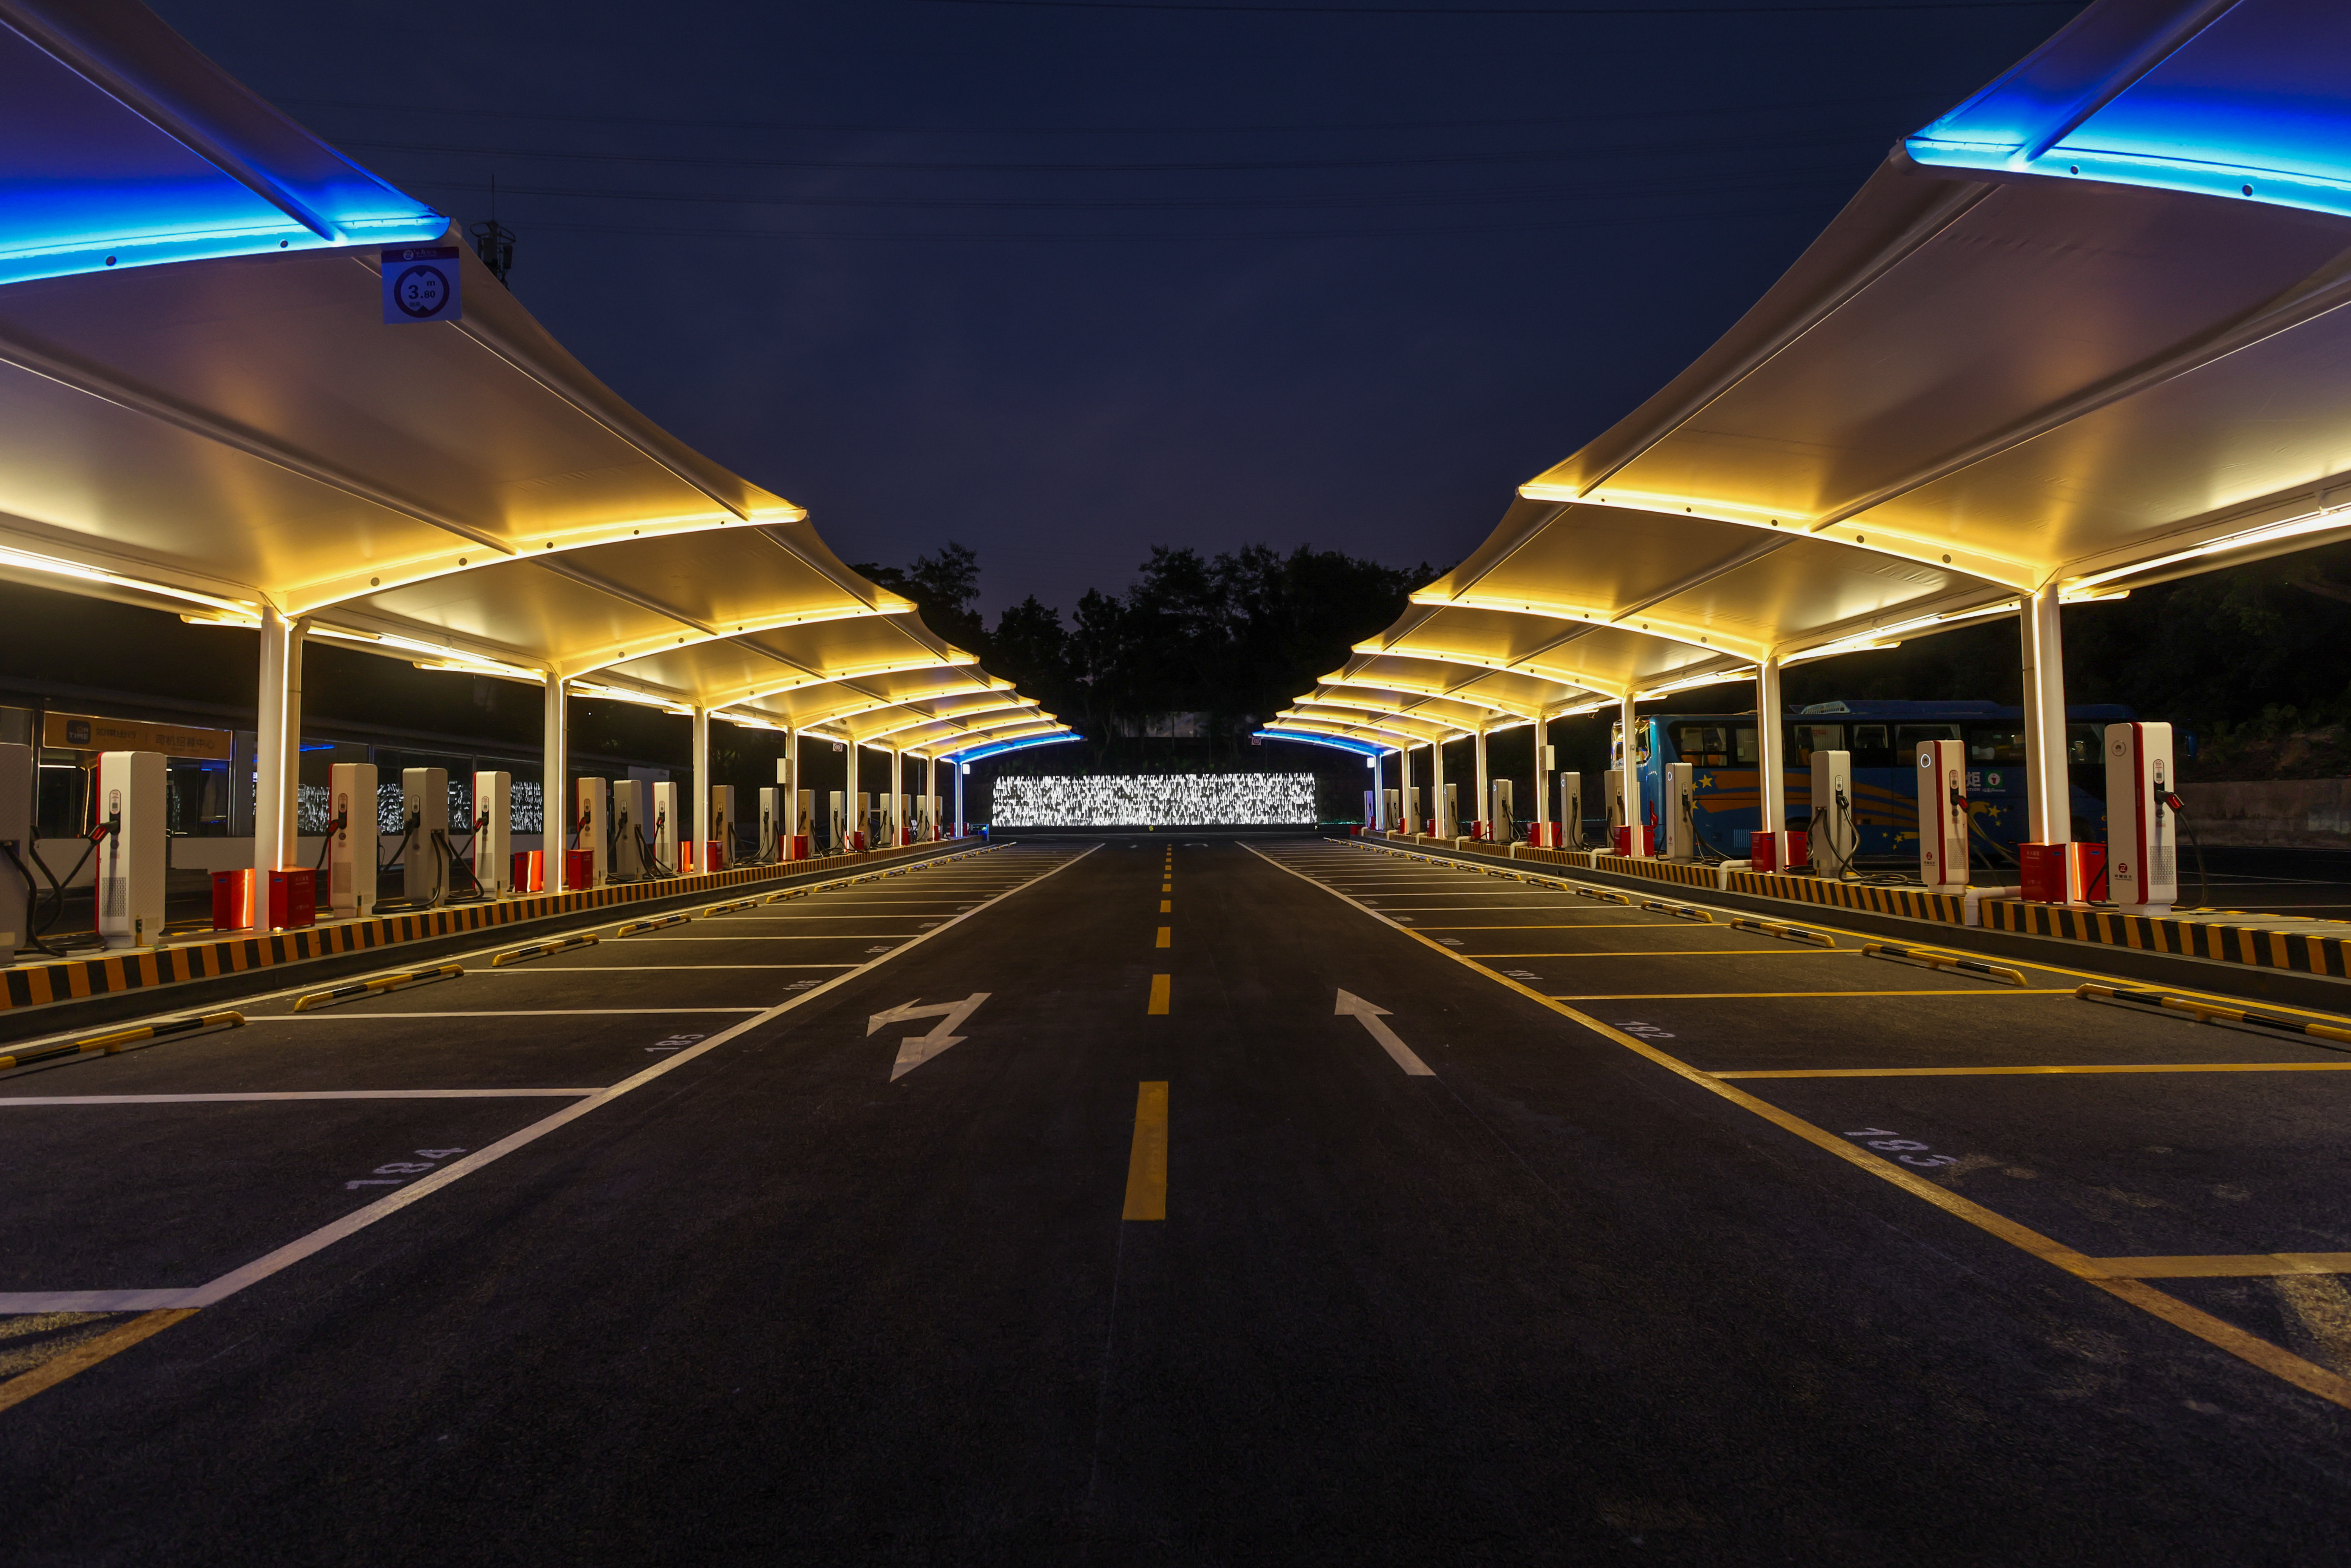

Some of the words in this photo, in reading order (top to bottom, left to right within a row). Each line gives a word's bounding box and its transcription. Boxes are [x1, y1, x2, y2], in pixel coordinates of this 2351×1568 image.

[1502, 970, 1543, 980] 181
[782, 980, 823, 990] 186
[1614, 1021, 1676, 1038] 182
[644, 1034, 705, 1052] 185
[1842, 1127, 1960, 1167] 183
[344, 1147, 468, 1190] 184
